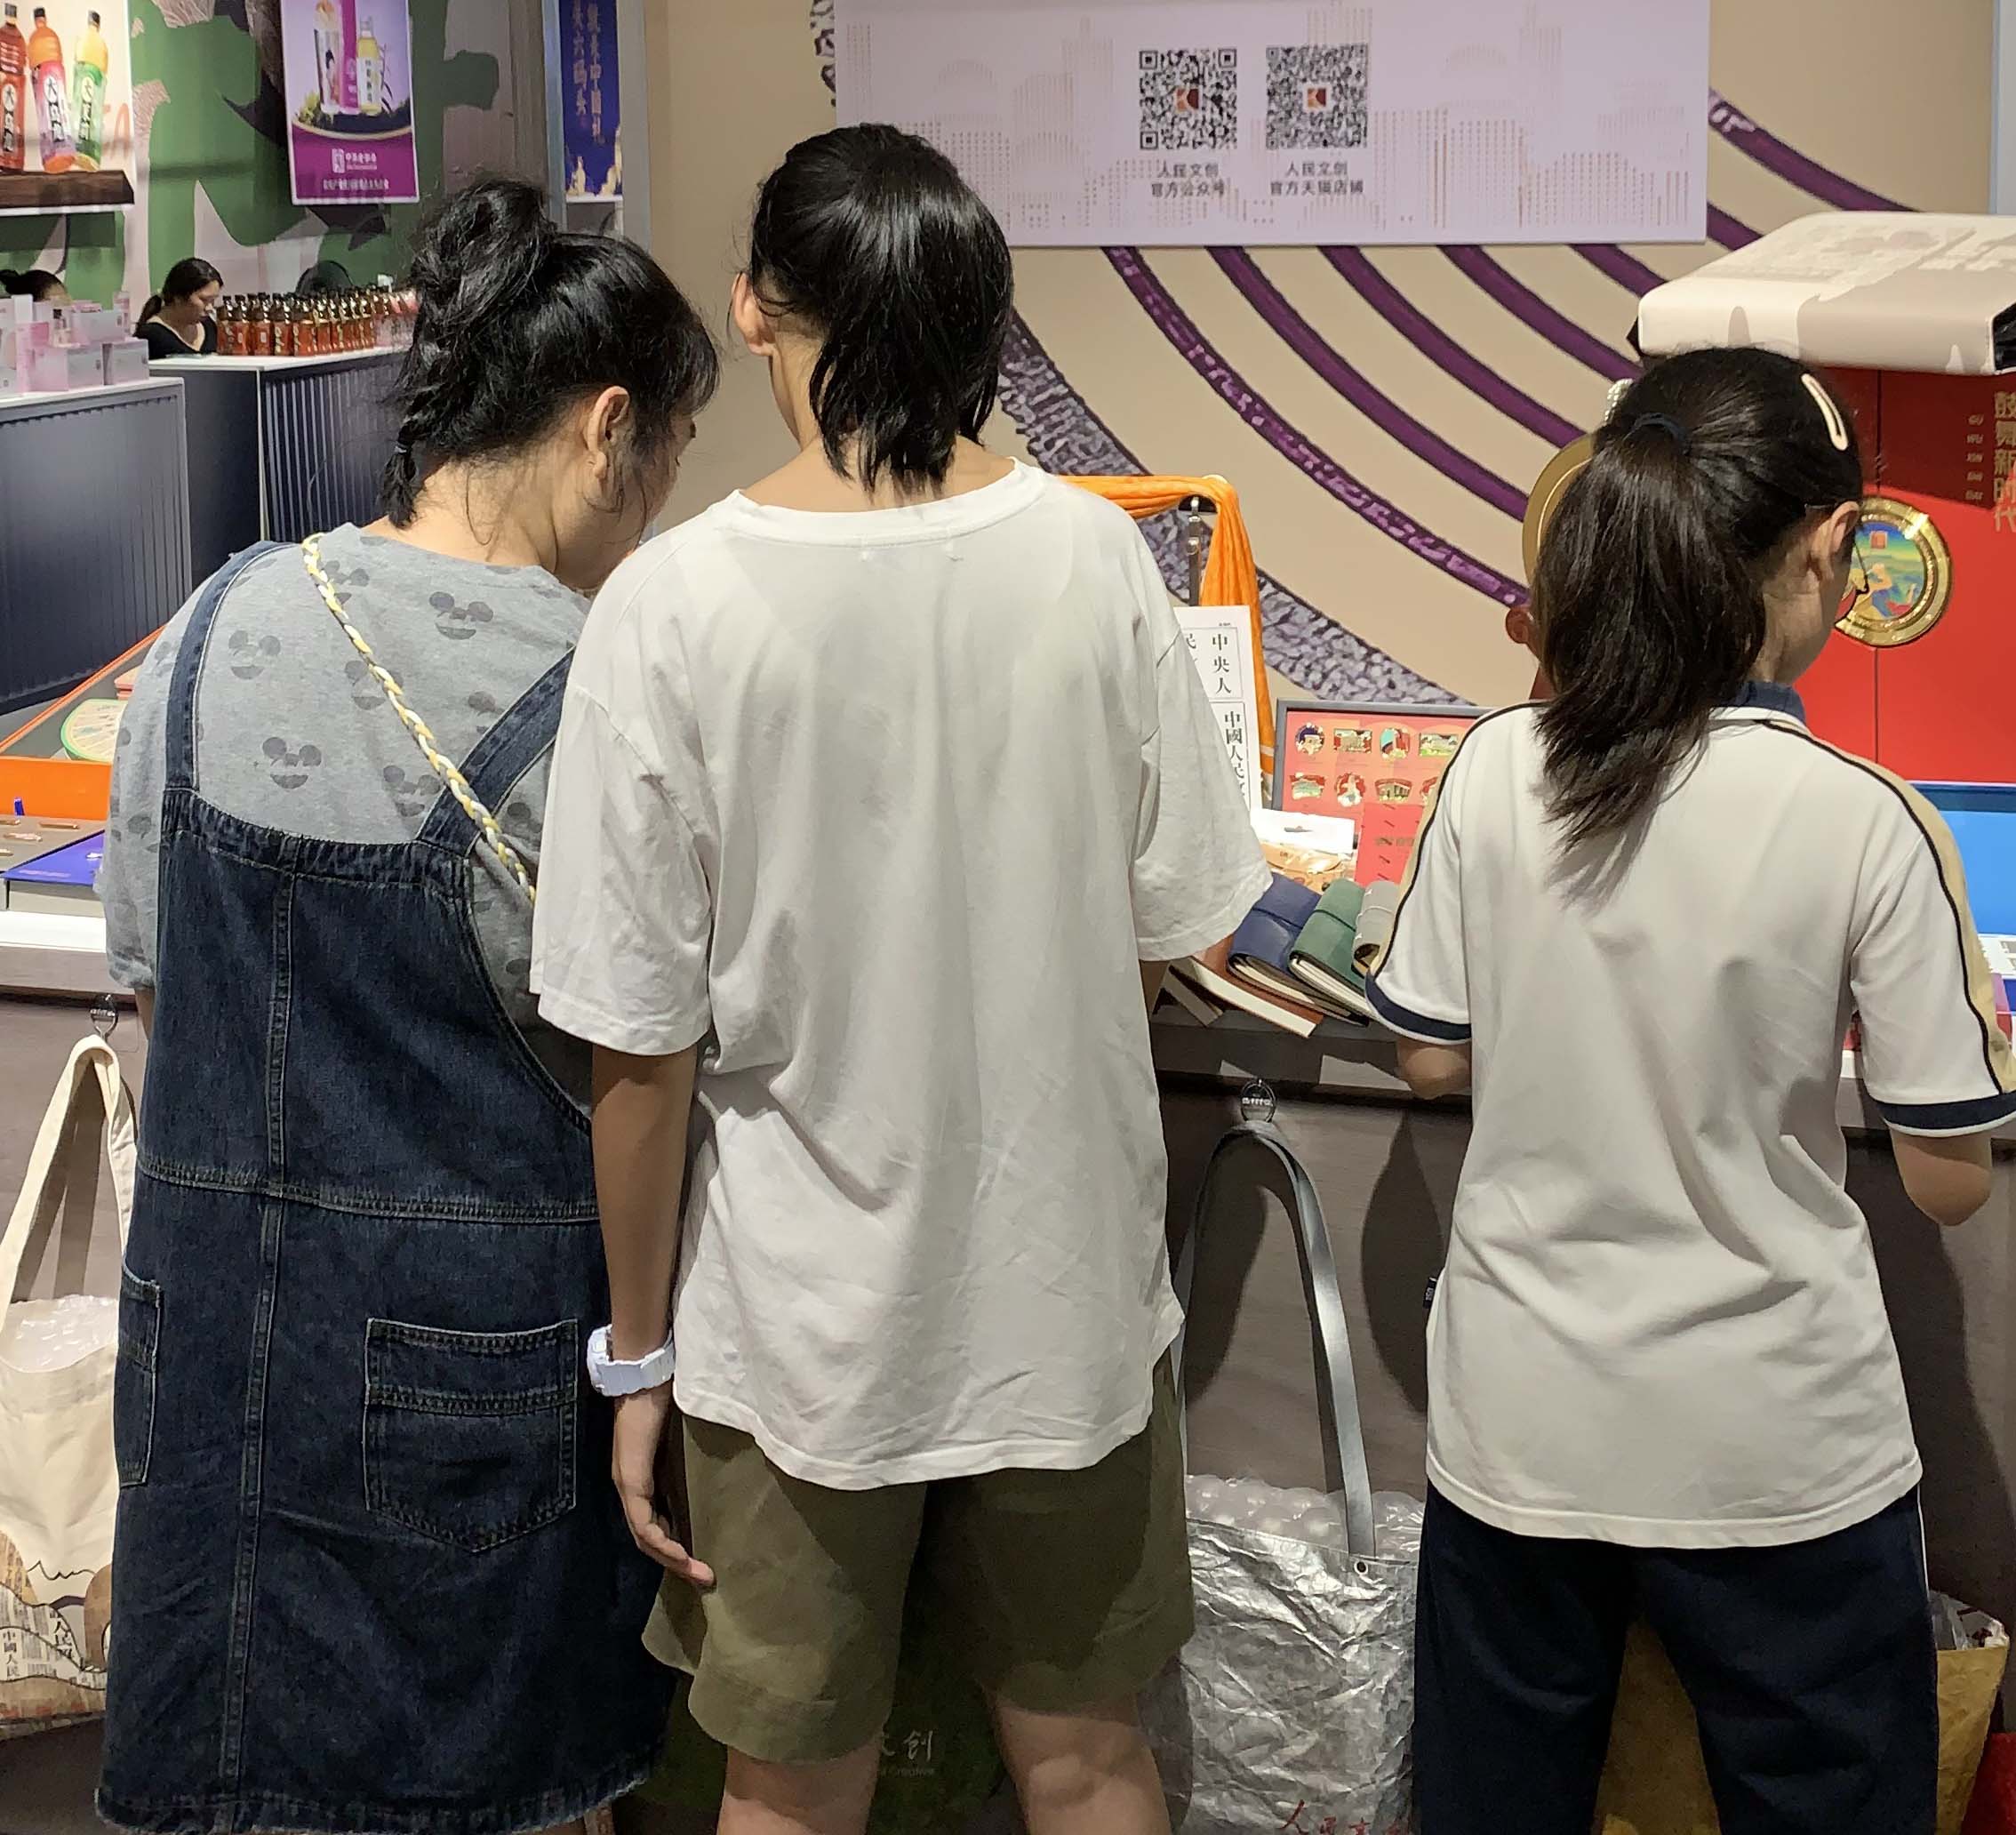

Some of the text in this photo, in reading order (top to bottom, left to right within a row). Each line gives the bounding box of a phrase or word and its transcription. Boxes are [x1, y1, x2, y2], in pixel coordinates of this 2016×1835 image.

[1157, 159, 1220, 178] 人民文创
[1285, 160, 1348, 177] 人民文创
[1151, 180, 1225, 198] 官方公众号
[1270, 180, 1364, 196] 官方天猫店铺
